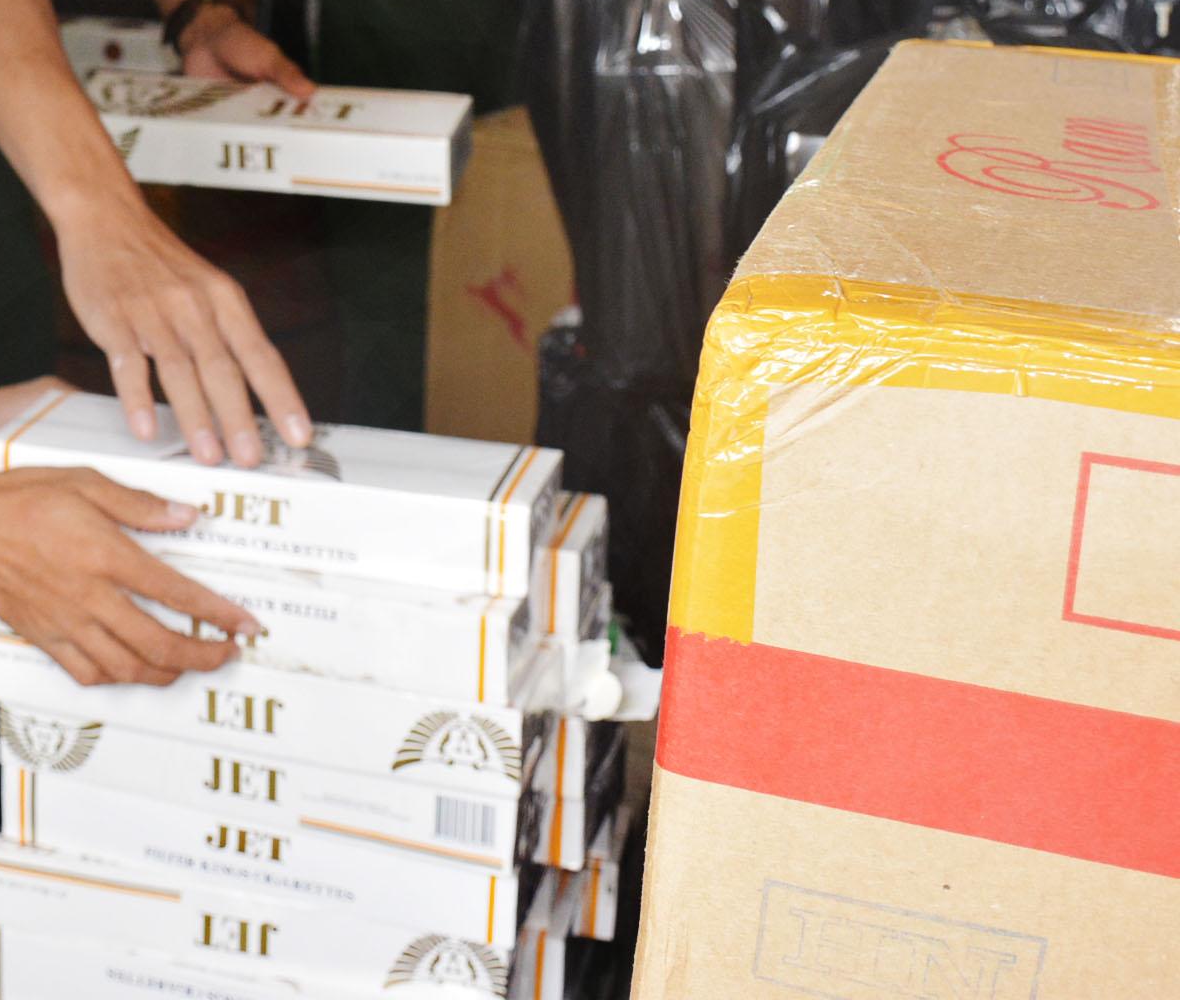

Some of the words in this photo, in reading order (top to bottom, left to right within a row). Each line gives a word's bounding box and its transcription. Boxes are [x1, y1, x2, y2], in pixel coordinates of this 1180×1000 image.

[217, 141, 282, 171] JET
[200, 491, 291, 526] JET
[197, 688, 284, 734] JET
[203, 756, 286, 803] JET
[205, 824, 290, 862] JET
[191, 912, 279, 957] JET
